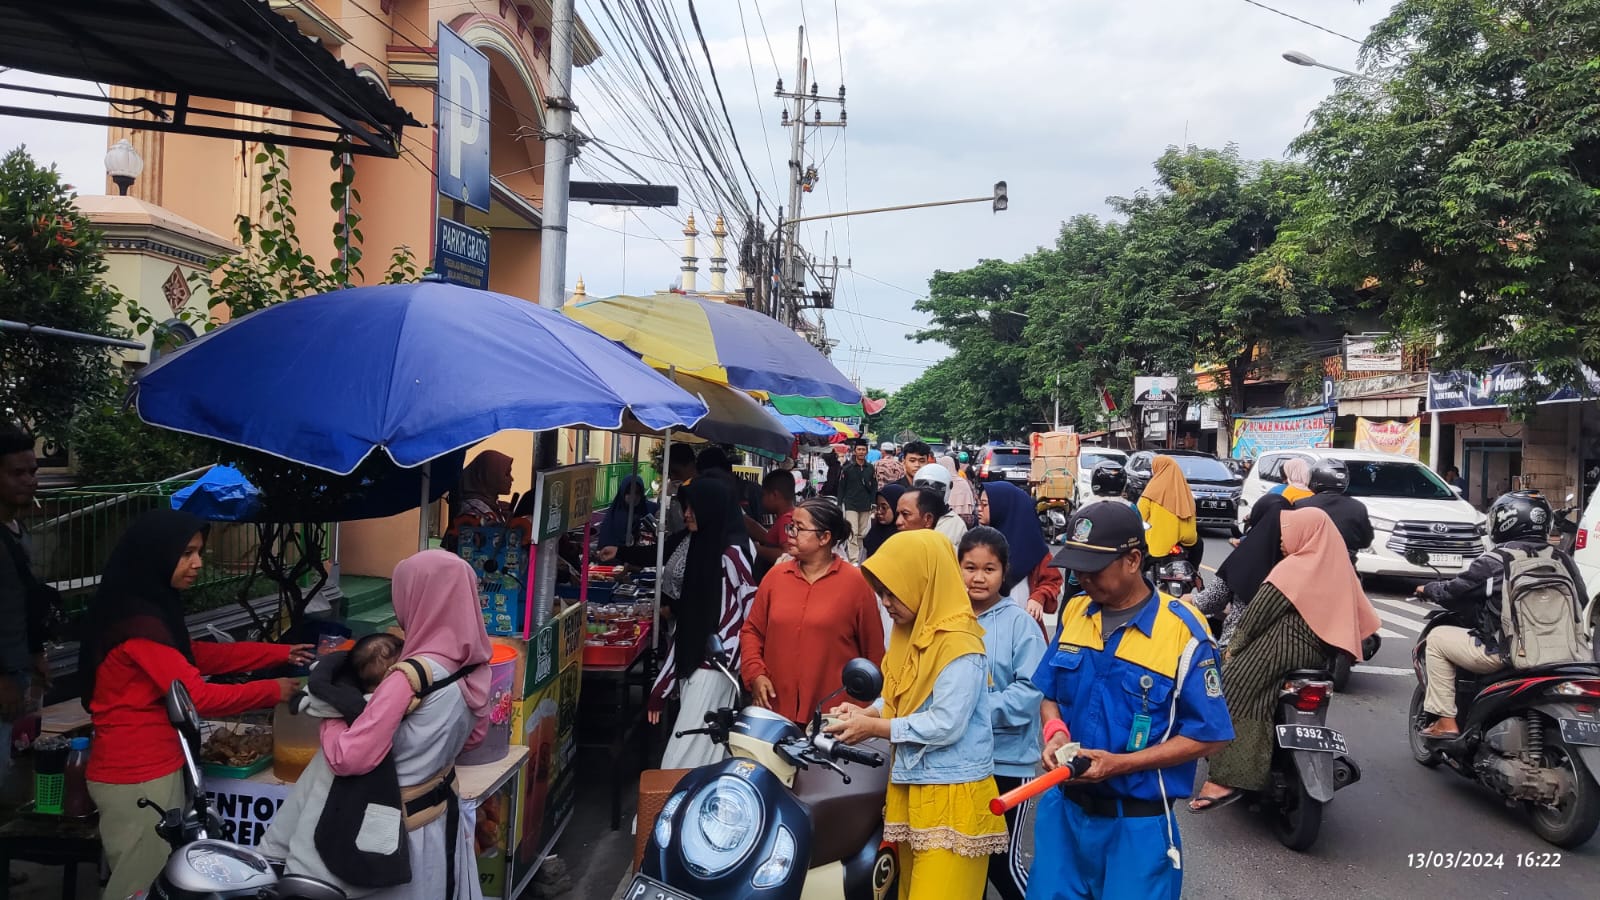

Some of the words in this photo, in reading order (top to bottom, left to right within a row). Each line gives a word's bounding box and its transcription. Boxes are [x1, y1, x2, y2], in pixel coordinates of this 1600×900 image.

[450, 53, 480, 180] P
[442, 225, 467, 255] PARKIR
[467, 234, 487, 263] GRATIS
[1324, 380, 1333, 404] P
[1279, 727, 1287, 737] P
[1296, 727, 1324, 740] 6392
[1561, 719, 1568, 731] P
[632, 883, 647, 900] P
